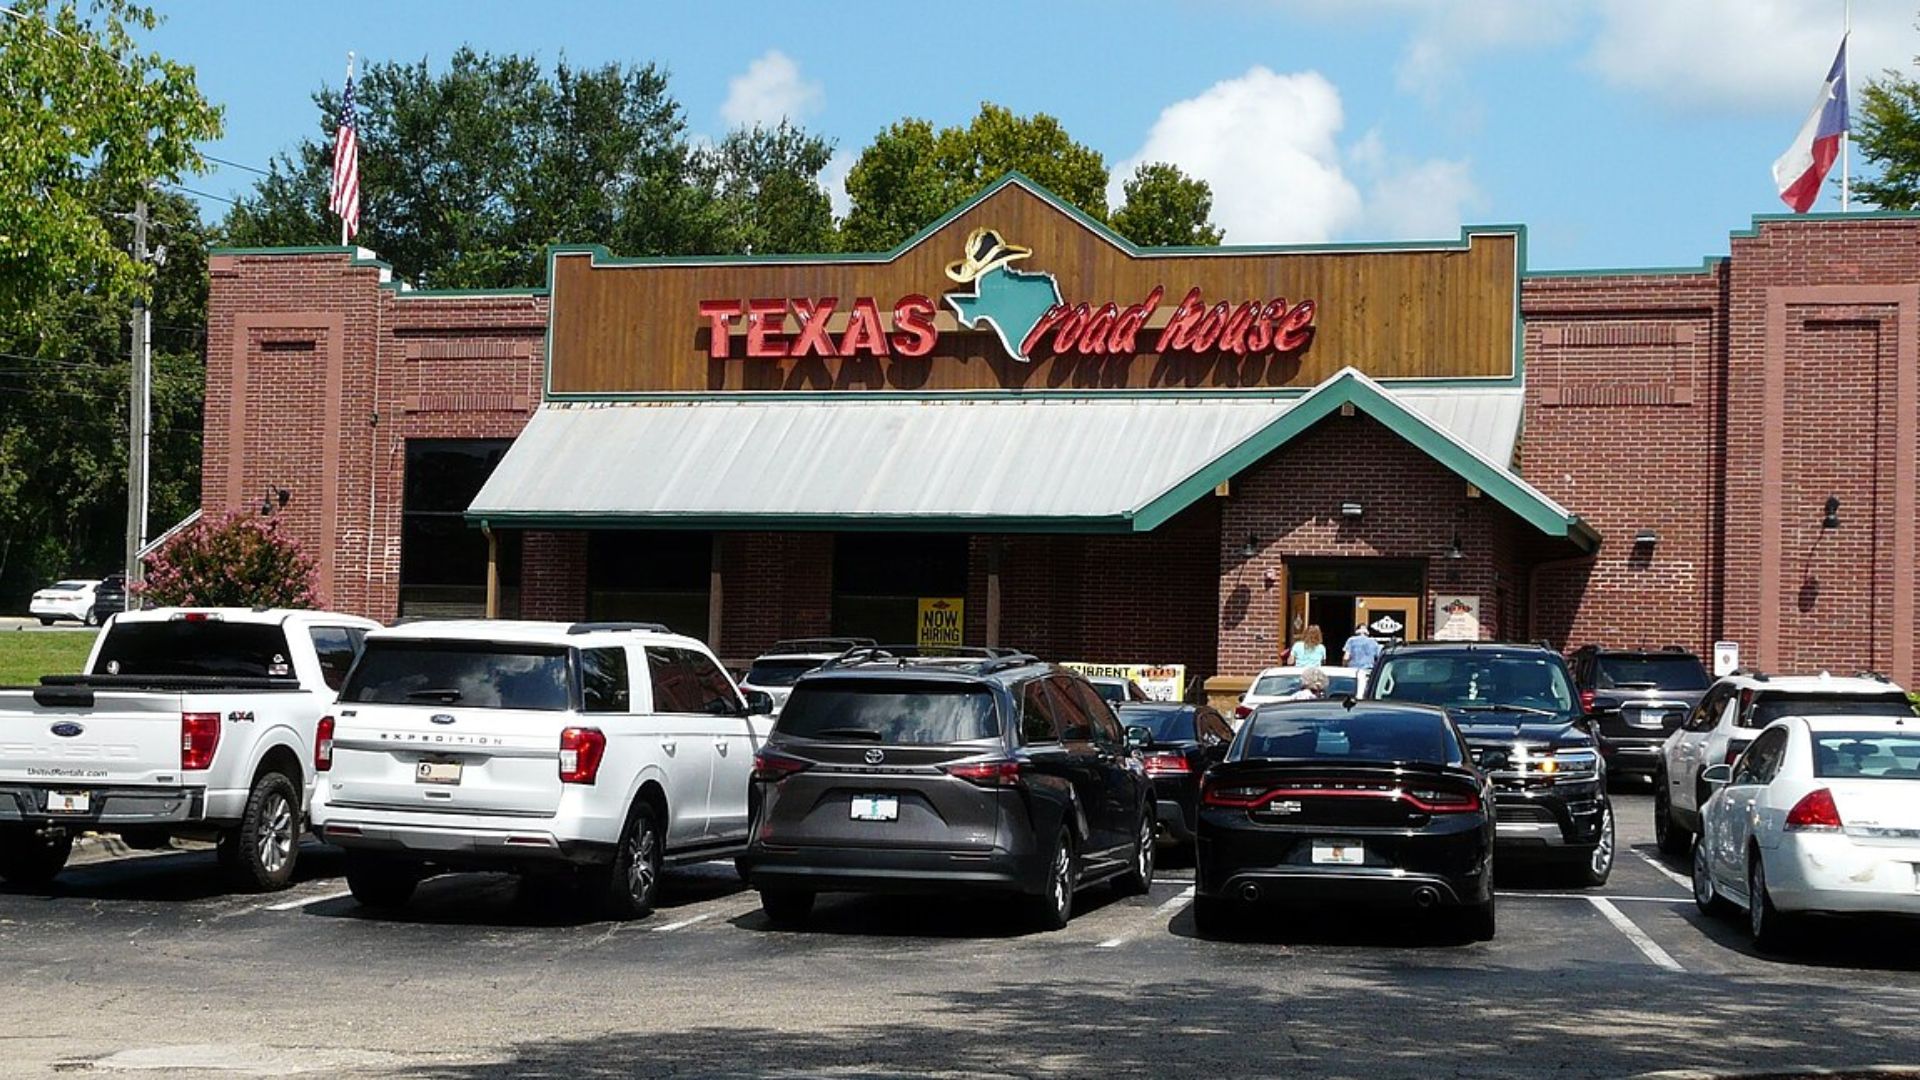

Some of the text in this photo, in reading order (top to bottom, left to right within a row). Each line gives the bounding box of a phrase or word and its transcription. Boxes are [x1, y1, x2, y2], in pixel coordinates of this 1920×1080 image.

[699, 284, 1317, 357] TEXAS road house
[924, 610, 958, 627] NOW
[921, 628, 960, 642] HIRING
[380, 733, 502, 745] EXPEDITION
